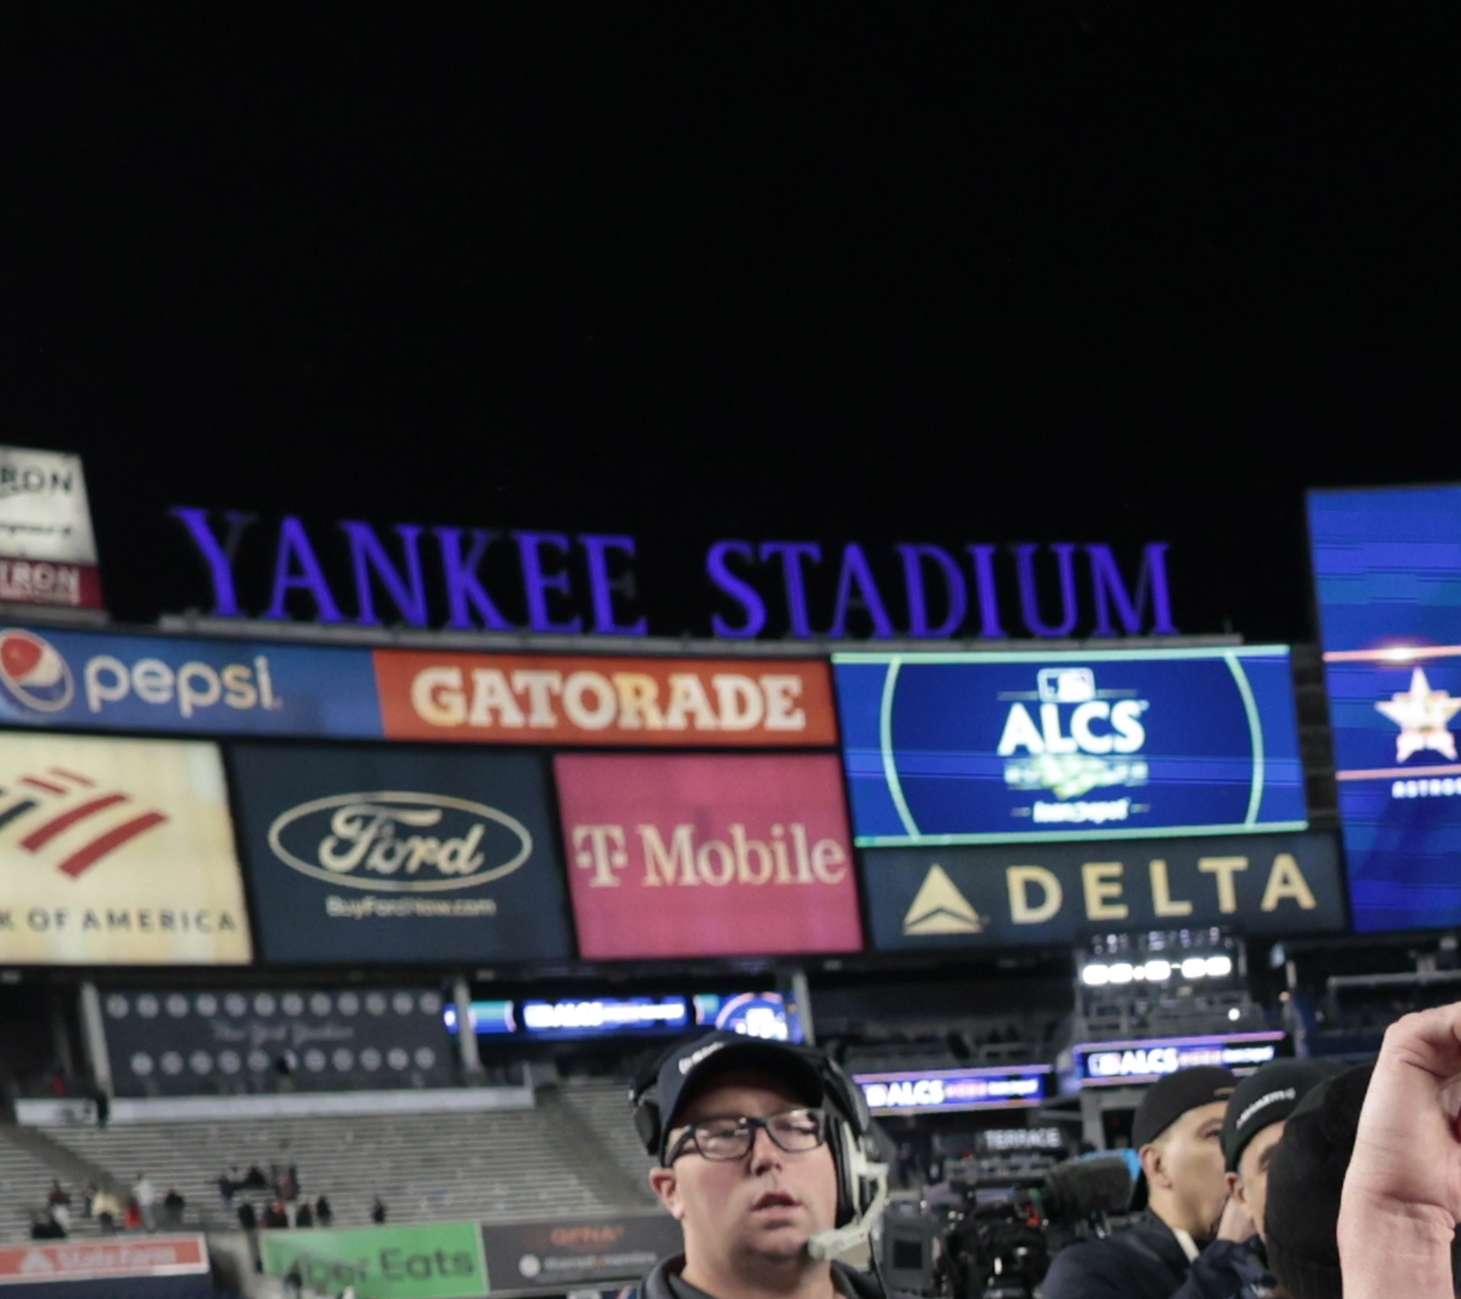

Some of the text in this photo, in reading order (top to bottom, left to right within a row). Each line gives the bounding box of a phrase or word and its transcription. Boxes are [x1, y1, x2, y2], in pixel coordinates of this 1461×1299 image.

[168, 506, 1181, 640] YANKEE STADIUM
[85, 655, 275, 718] pepsi
[411, 666, 806, 734] GATORADE
[996, 700, 1146, 757] ALCS
[318, 803, 486, 876] Ford
[637, 824, 849, 889] Mobile
[1005, 852, 1319, 926] DELTA
[26, 908, 70, 933] OF
[82, 908, 240, 934] AMERICA
[887, 1080, 945, 1106] ALCS
[1120, 1048, 1178, 1076] ALCS
[380, 1246, 474, 1281] Eats
